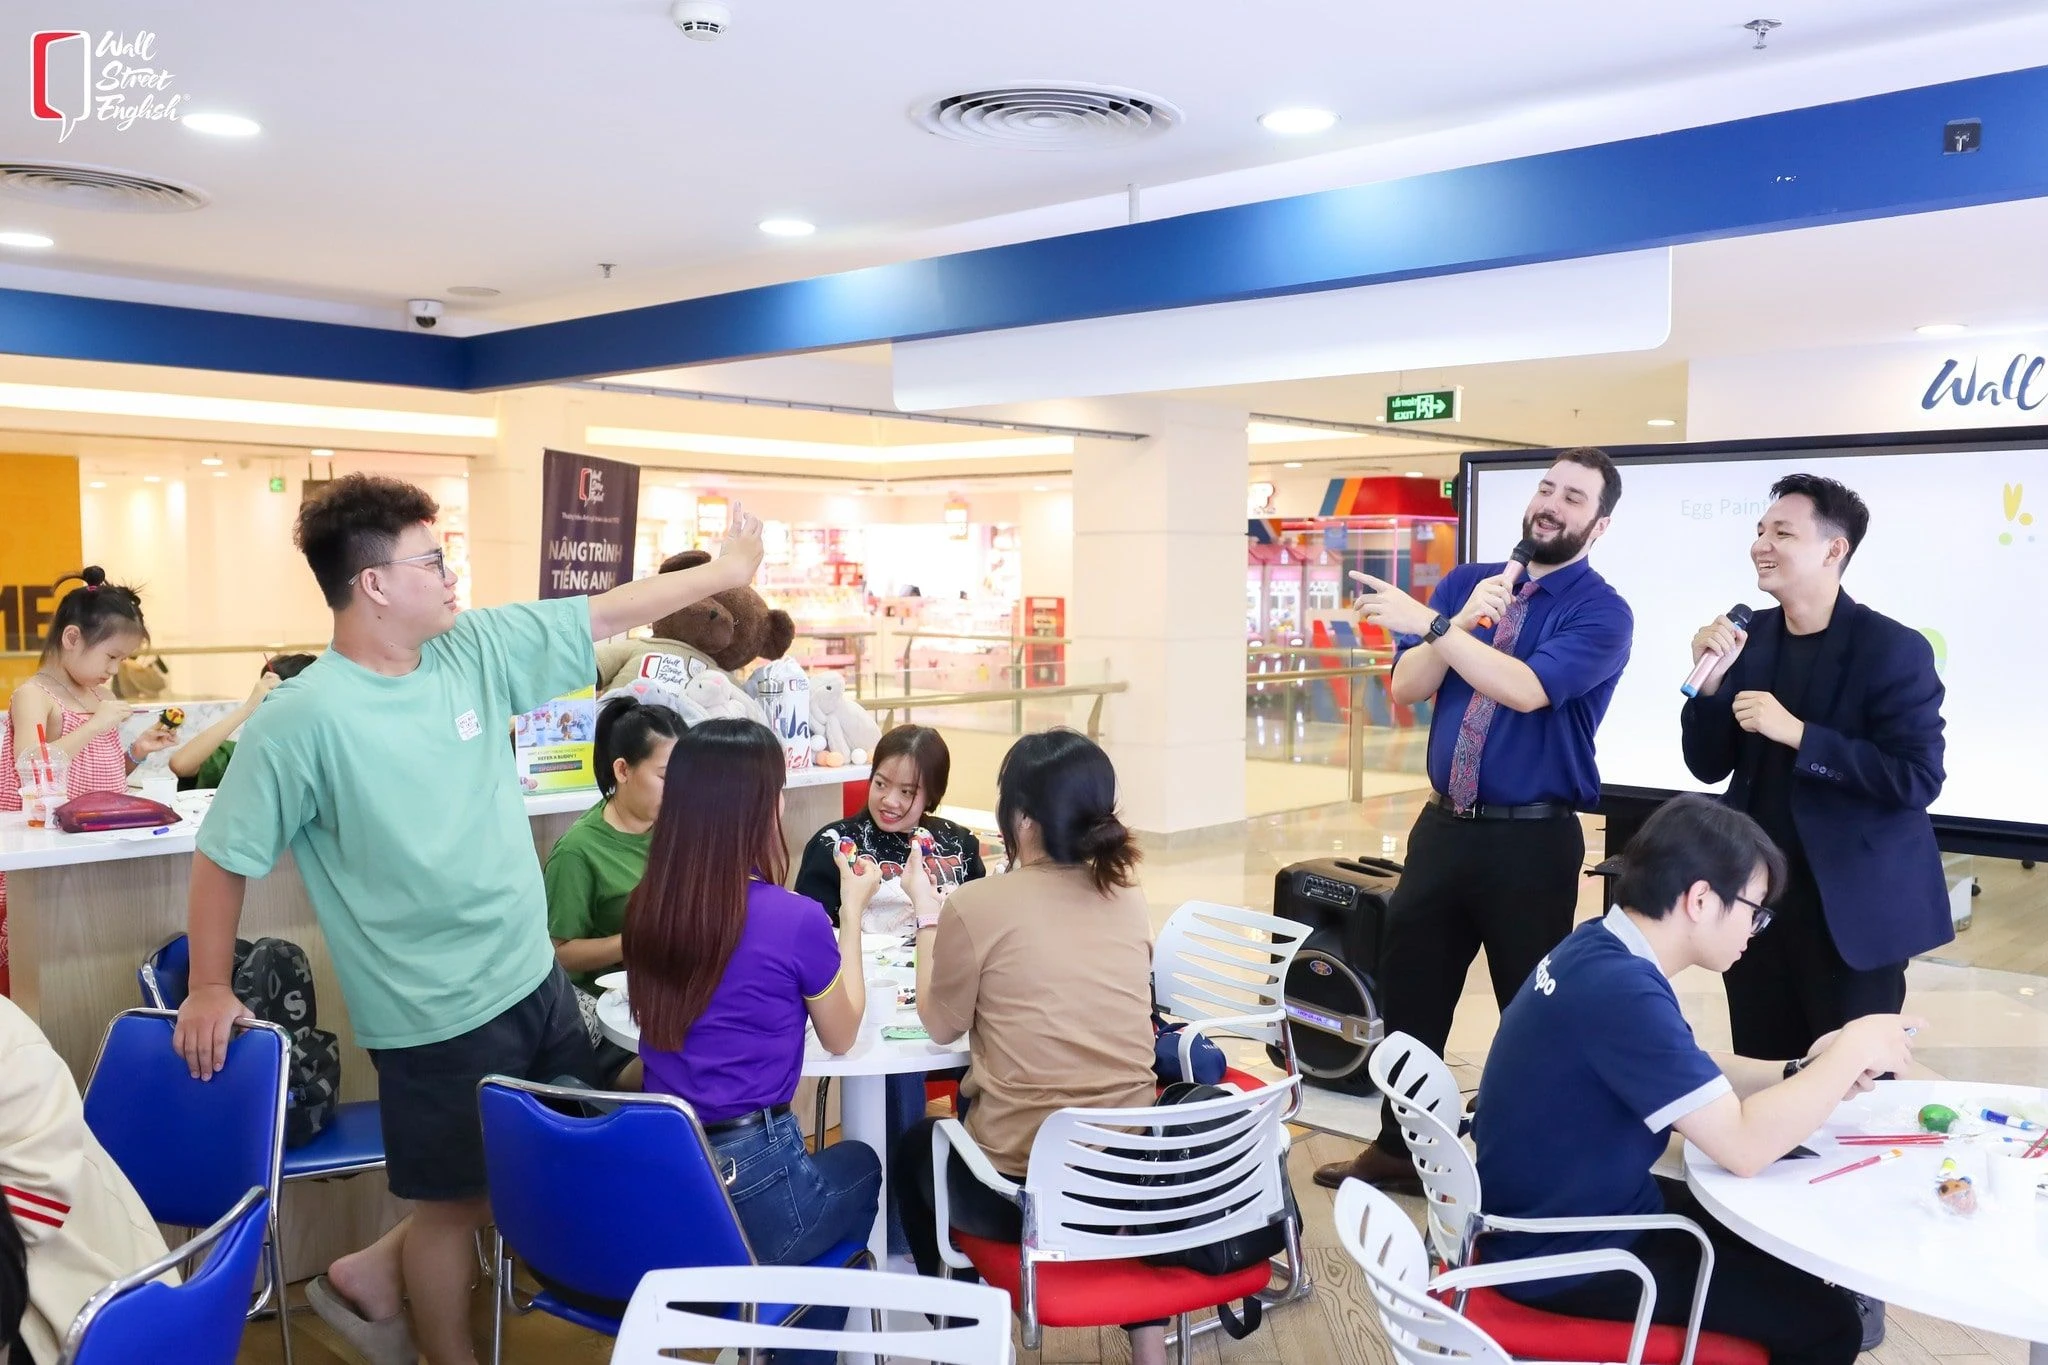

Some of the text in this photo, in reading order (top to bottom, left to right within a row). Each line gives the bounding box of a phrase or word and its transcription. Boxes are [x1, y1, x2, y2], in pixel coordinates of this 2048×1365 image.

[1921, 353, 2048, 411] Wall
[1393, 410, 1415, 421] EXIT
[1681, 499, 1713, 520] Egg
[549, 535, 623, 563] NÂNG TRÌNH
